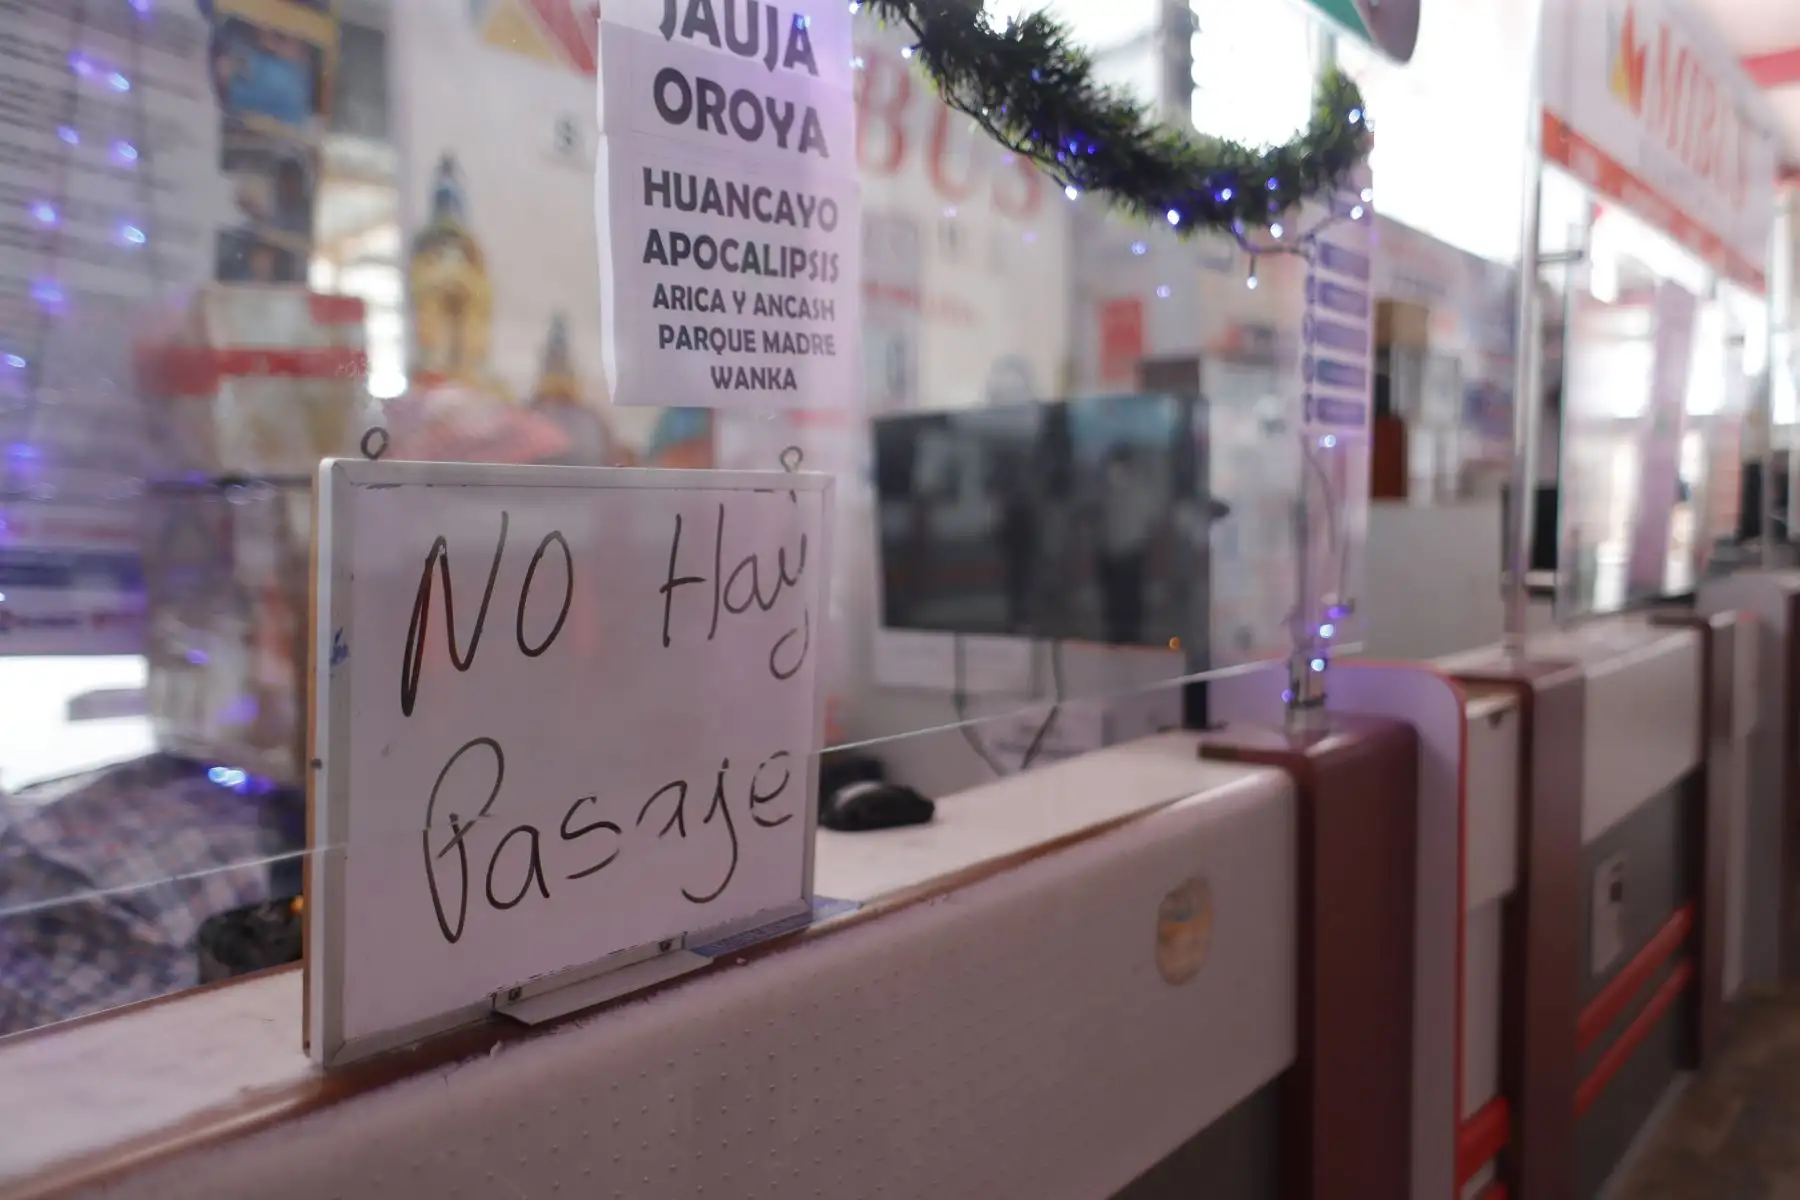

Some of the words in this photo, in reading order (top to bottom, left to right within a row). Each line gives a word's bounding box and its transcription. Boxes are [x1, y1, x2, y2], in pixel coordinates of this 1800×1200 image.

[659, 0, 819, 76] JAUJA
[653, 67, 830, 158] OROYA
[643, 166, 838, 232] HUANCAYO
[642, 228, 839, 284] APOCALIPSIS
[653, 283, 726, 315] ARICA
[733, 291, 747, 315] Y
[753, 292, 835, 322] ANCASH
[658, 325, 756, 356] PARQUE
[762, 330, 836, 356] MADRE
[710, 366, 798, 391] WANKA
[400, 510, 575, 718] NO
[659, 502, 809, 681] Hay
[422, 736, 795, 944] Pasaje
